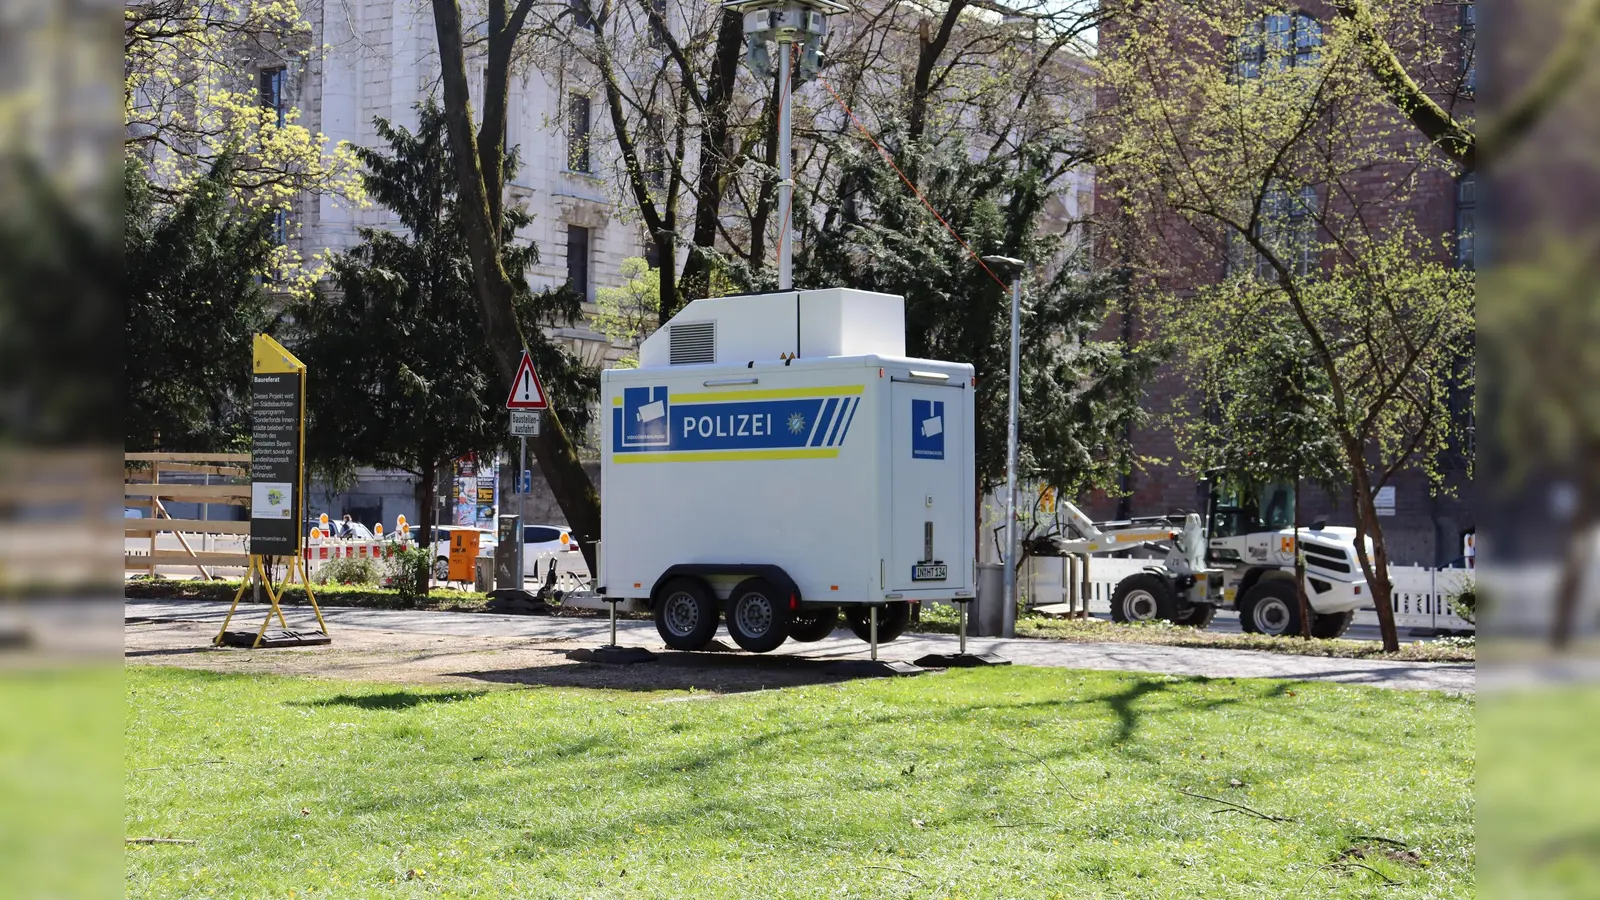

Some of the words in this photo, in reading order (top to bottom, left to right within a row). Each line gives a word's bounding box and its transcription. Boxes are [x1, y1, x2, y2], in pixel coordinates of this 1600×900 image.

[268, 392, 284, 400] Projekt
[512, 413, 539, 424] Baustellen-
[514, 423, 535, 434] ausfahrt
[683, 413, 773, 438] POLIZEI
[276, 440, 292, 448] Bayern
